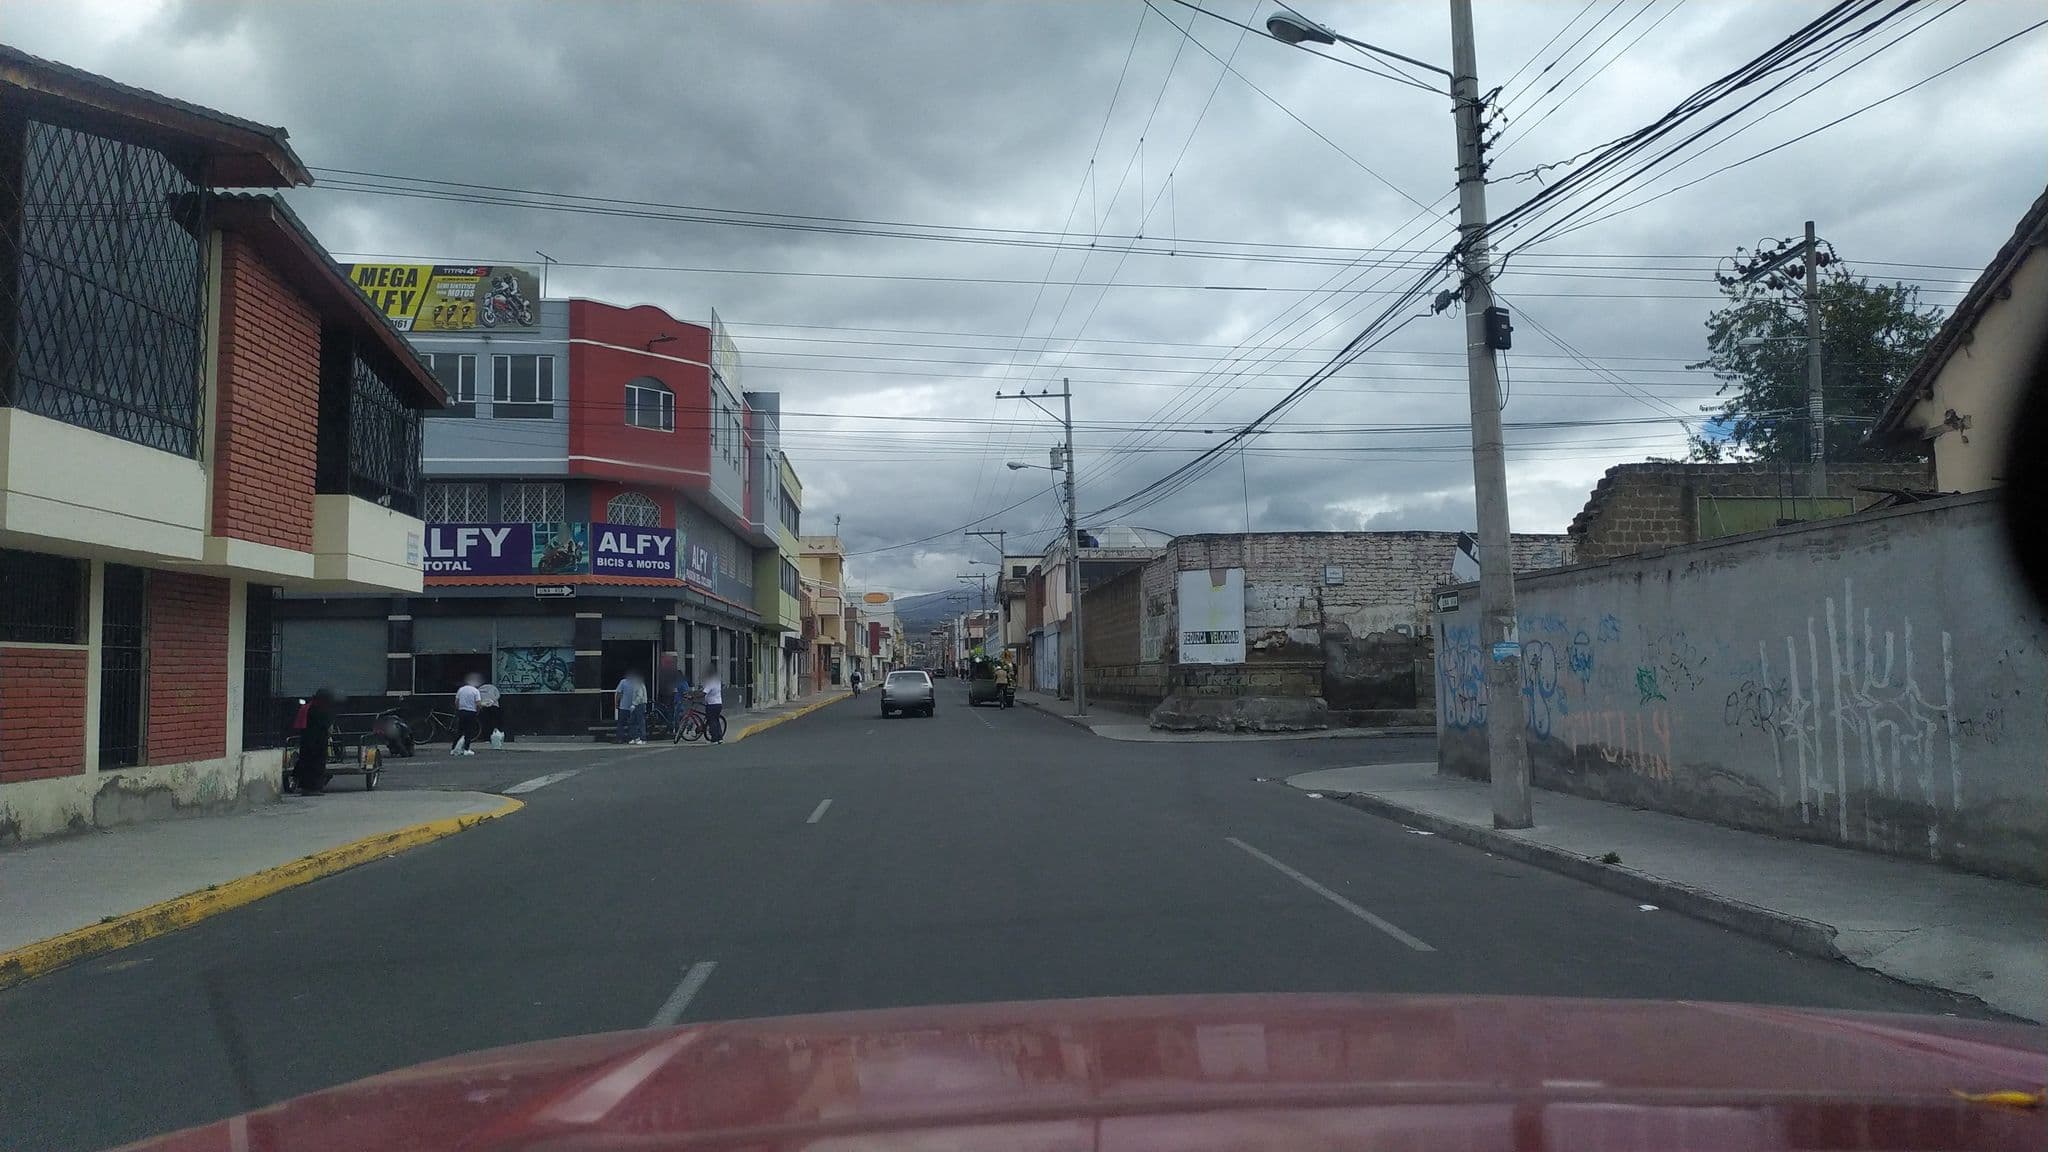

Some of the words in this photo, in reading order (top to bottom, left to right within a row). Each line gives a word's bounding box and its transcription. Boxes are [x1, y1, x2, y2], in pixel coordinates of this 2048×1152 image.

[359, 267, 417, 287] MEGA
[363, 290, 416, 315] LFY
[447, 289, 475, 297] MOTOS
[423, 528, 512, 558] LFY
[598, 531, 672, 556] ALFY
[423, 561, 472, 571] TOTAL
[597, 557, 625, 568] BICIS
[627, 560, 634, 568] &
[637, 559, 671, 570] MOTOS
[691, 544, 708, 574] ALFY
[1183, 631, 1207, 644] REDUZCA
[1210, 631, 1239, 644] VELOCIDAD
